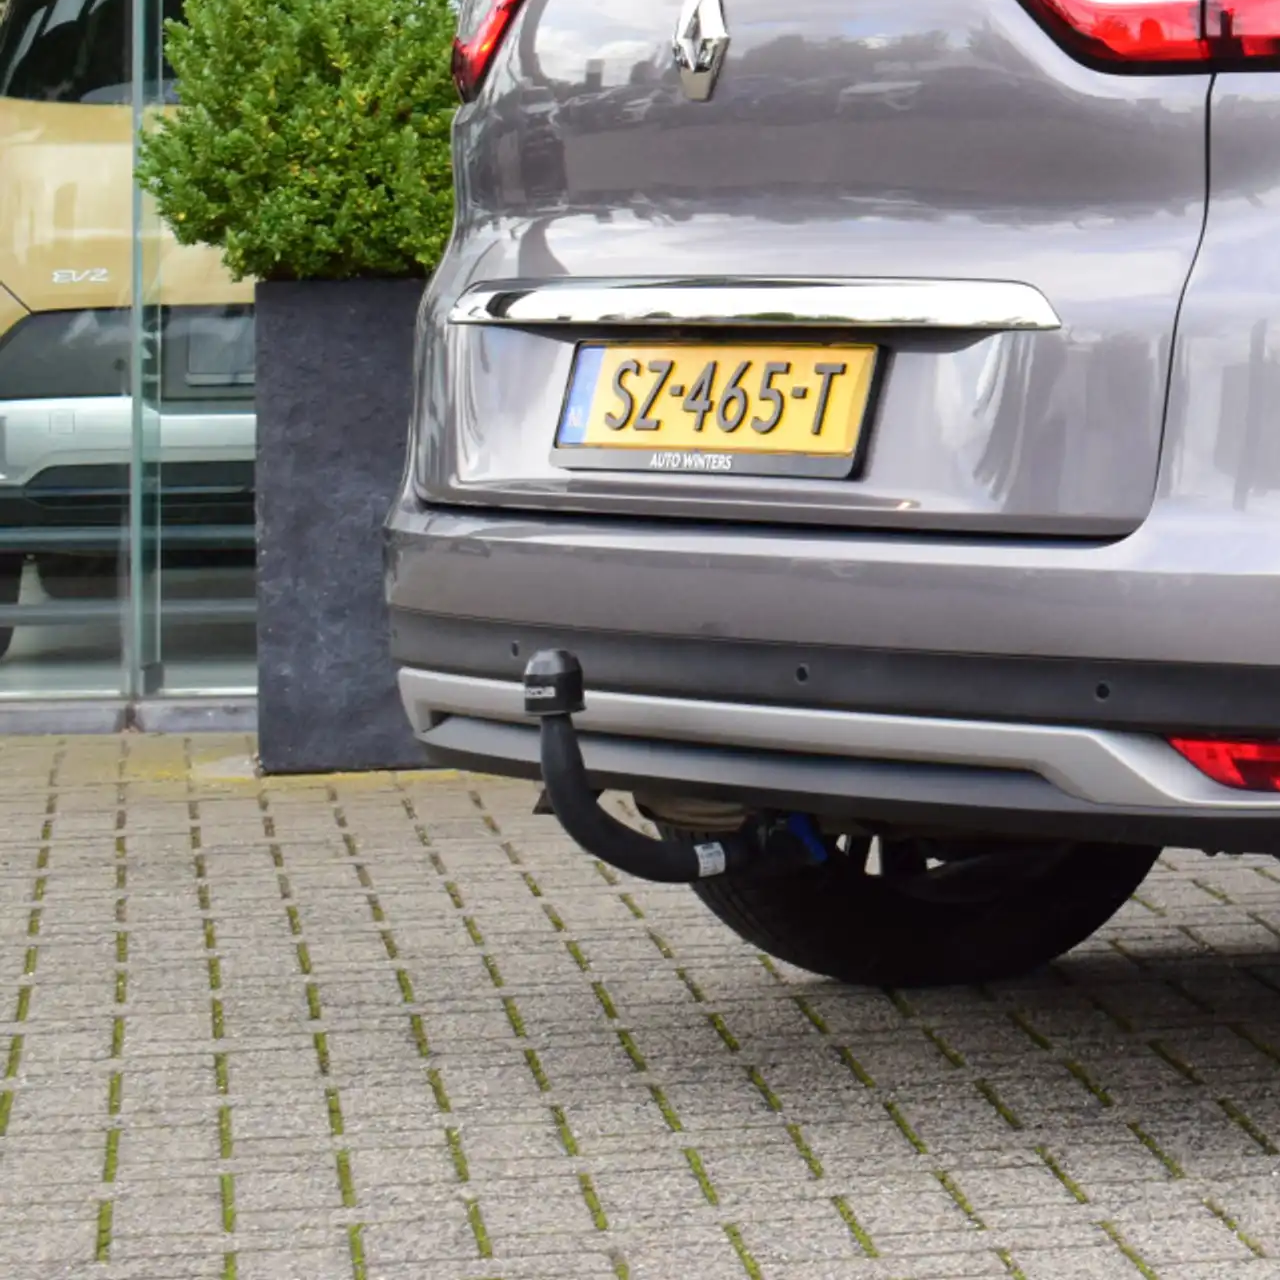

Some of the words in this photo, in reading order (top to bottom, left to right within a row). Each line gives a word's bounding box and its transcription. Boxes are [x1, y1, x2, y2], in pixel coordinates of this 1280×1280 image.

[603, 358, 847, 436] SZ-465-T
[650, 451, 681, 469] AUTO
[682, 452, 733, 471] WINTERS
